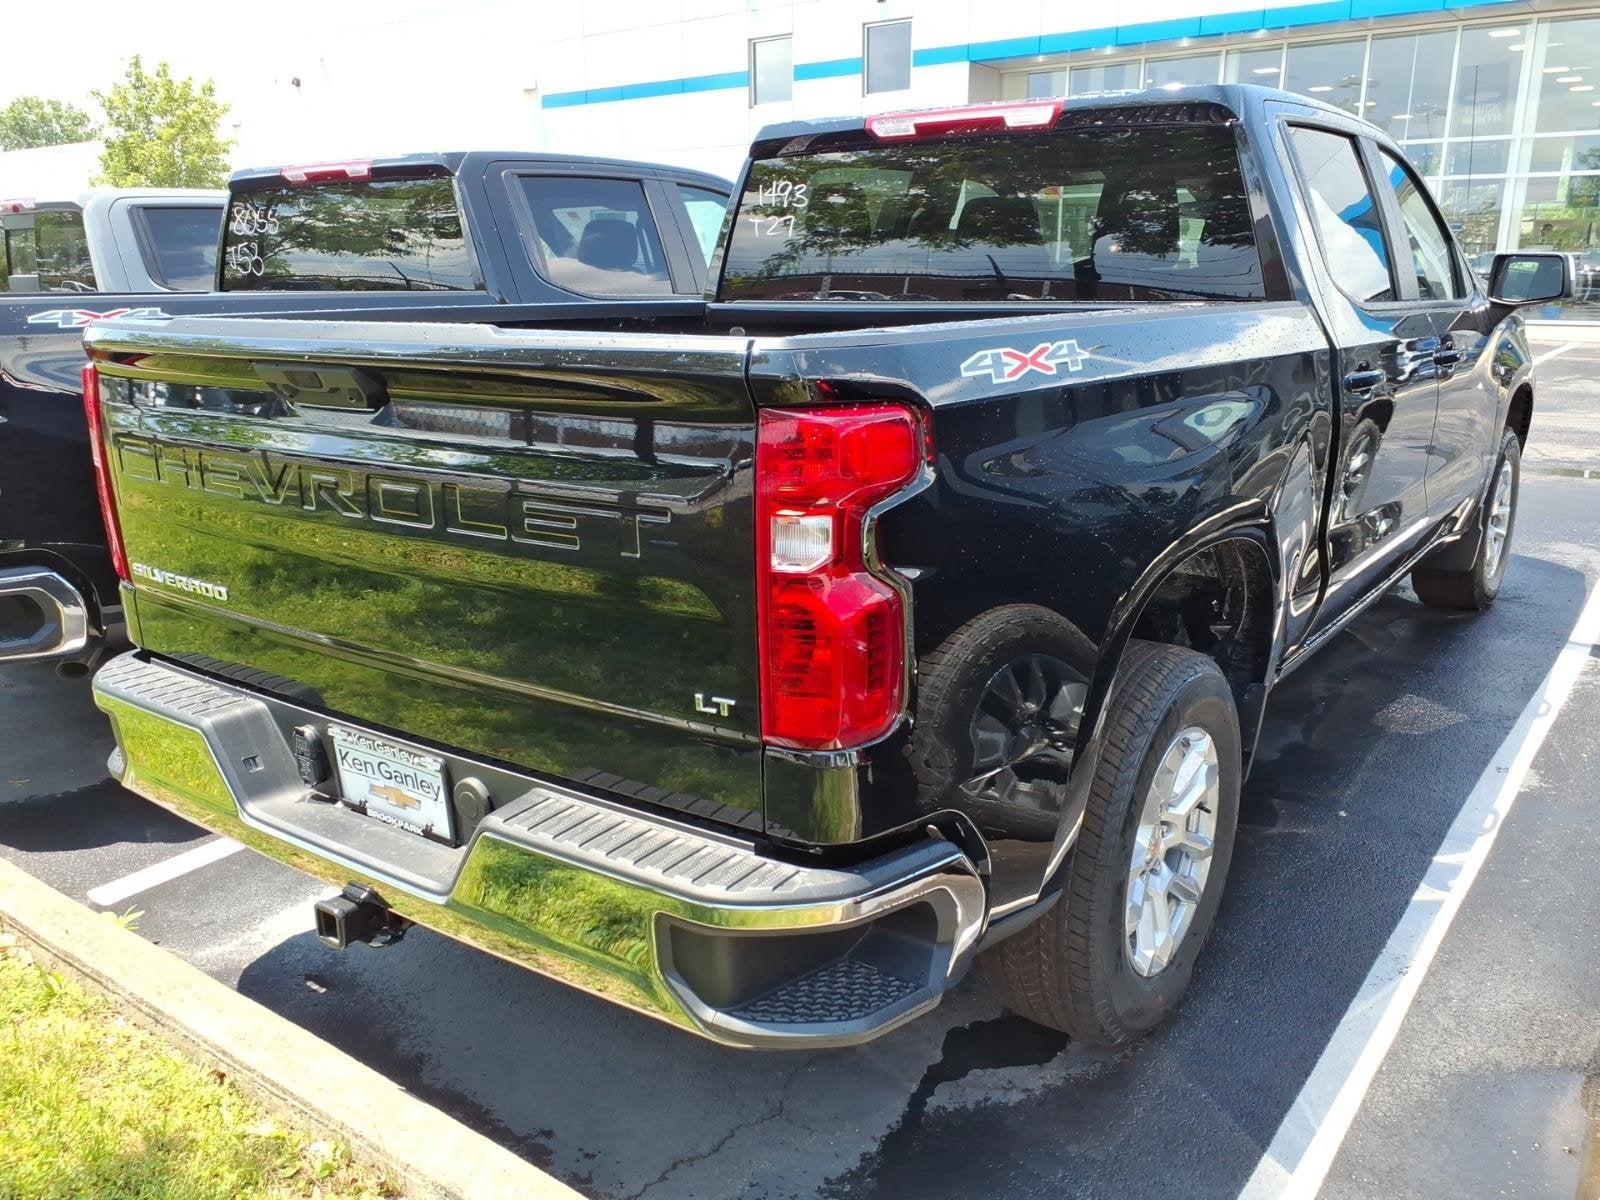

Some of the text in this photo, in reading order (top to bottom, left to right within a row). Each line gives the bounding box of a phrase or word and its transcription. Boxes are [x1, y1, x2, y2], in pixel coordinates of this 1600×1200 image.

[760, 180, 808, 208] 1493
[234, 205, 279, 235] 8055
[749, 215, 795, 238] T27
[960, 339, 1090, 384] 4X4
[117, 437, 671, 558] CHEVROLET
[132, 562, 228, 601] SILVERADO
[694, 693, 736, 717] LT
[352, 733, 416, 765] Ken Ganley
[339, 748, 441, 801] Ken Ganley
